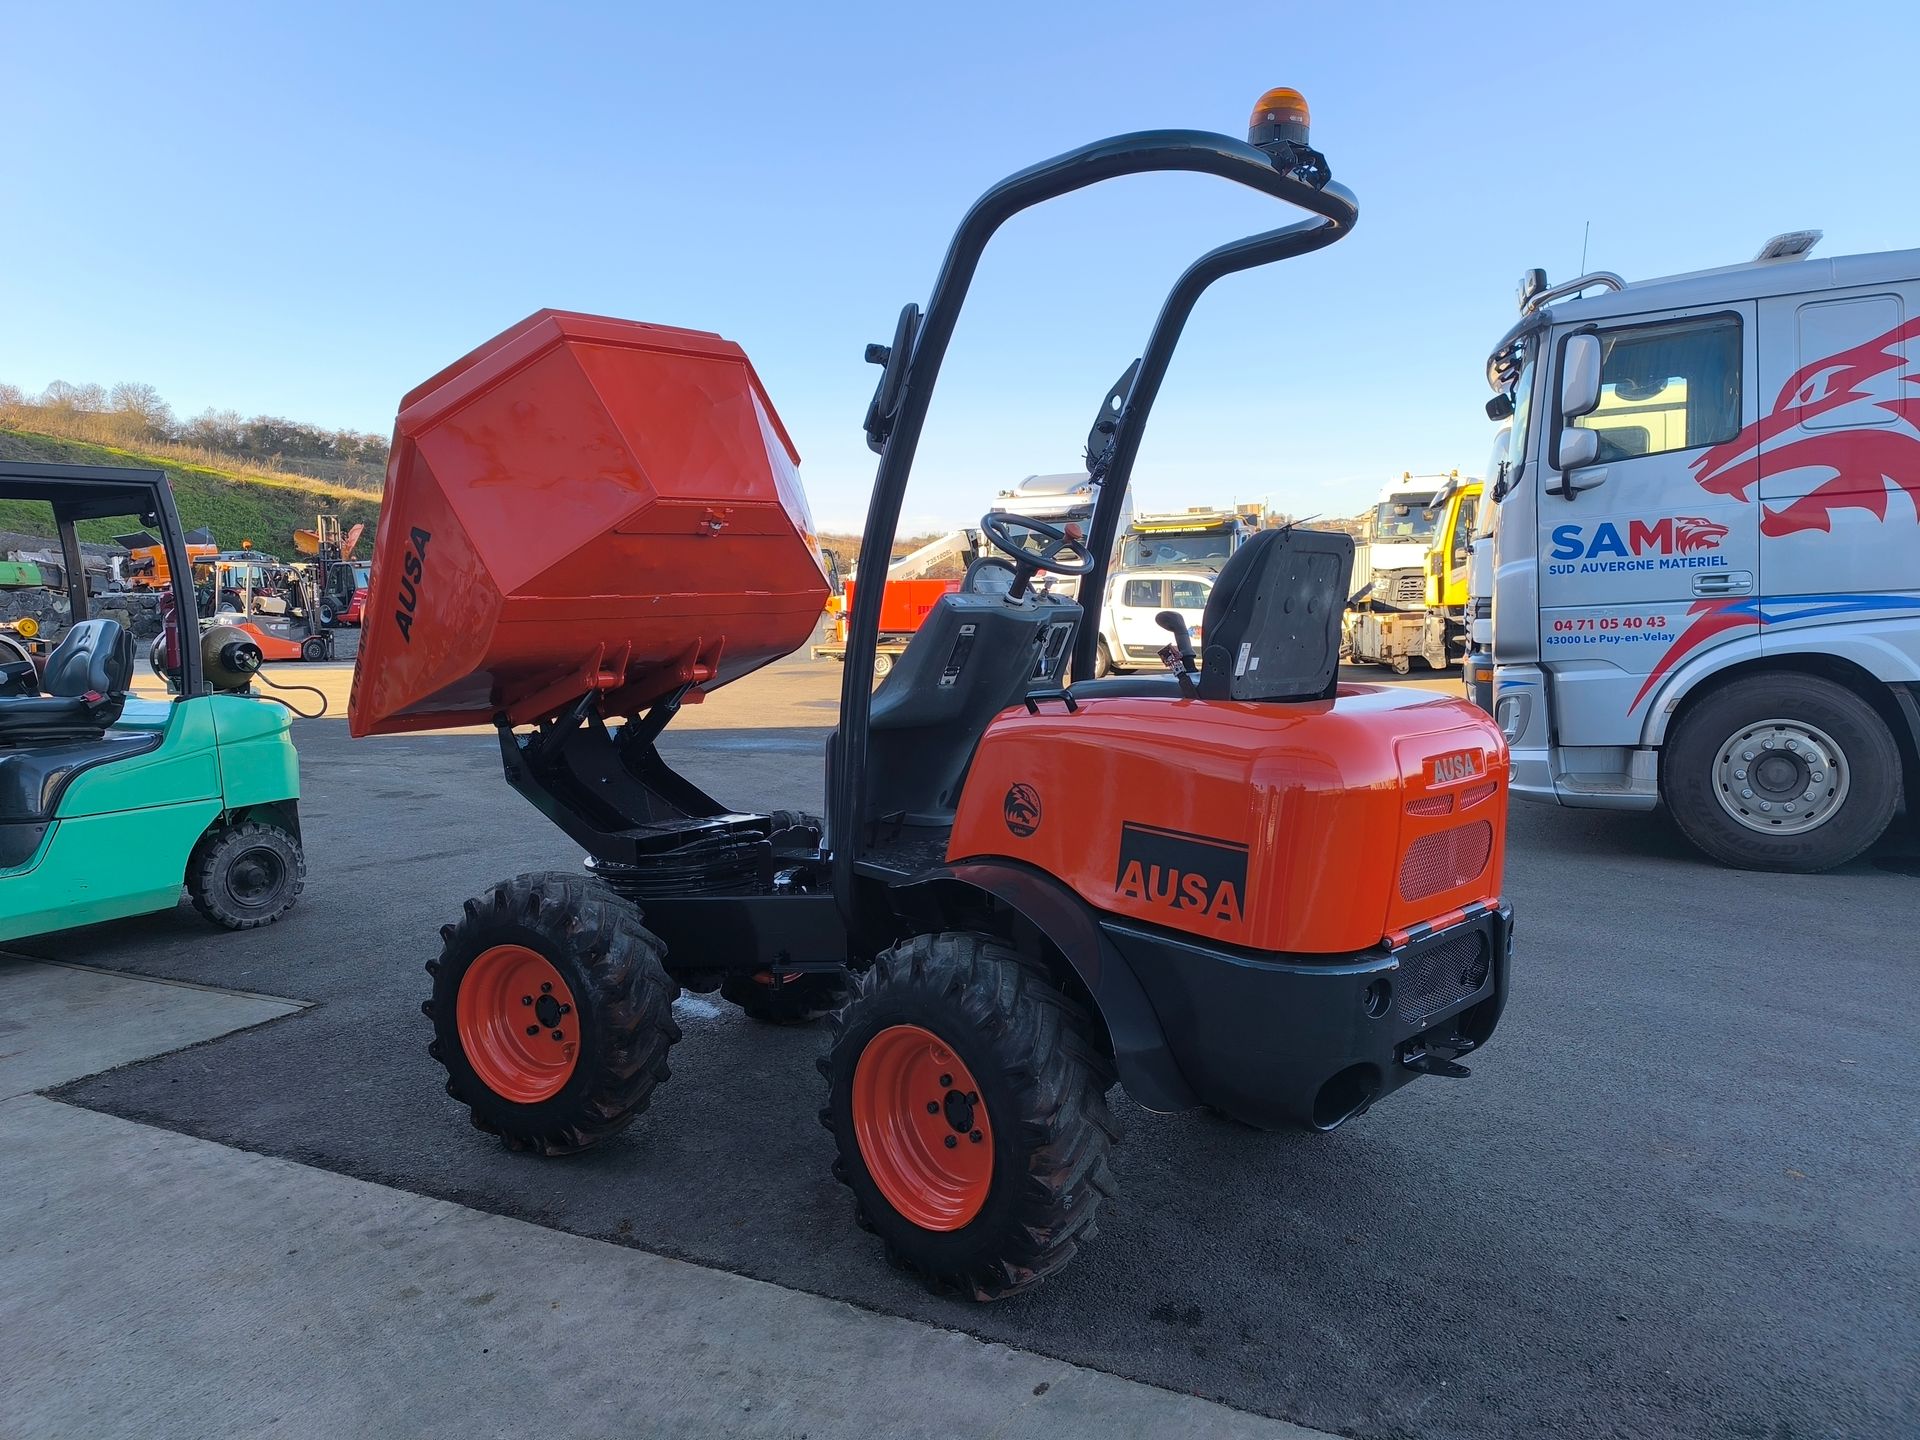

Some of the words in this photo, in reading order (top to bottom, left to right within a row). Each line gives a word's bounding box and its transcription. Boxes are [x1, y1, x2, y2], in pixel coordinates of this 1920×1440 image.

[1550, 518, 1673, 561] SAM
[1549, 564, 1575, 575] SUD
[1580, 559, 1654, 573] AUVERGNE
[1659, 555, 1728, 570] MATERIEL
[395, 526, 431, 644] AUSA
[1546, 635, 1581, 645] 43000
[1584, 635, 1597, 644] Le
[1600, 632, 1675, 645] Puy-en-Velay
[1554, 619, 1573, 632] 04
[1577, 618, 1594, 631] 71
[1600, 618, 1619, 630] 05
[1622, 616, 1643, 629] 40
[1646, 615, 1666, 628] 43
[1434, 752, 1476, 784] AUSA
[1117, 859, 1243, 922] AUSA
